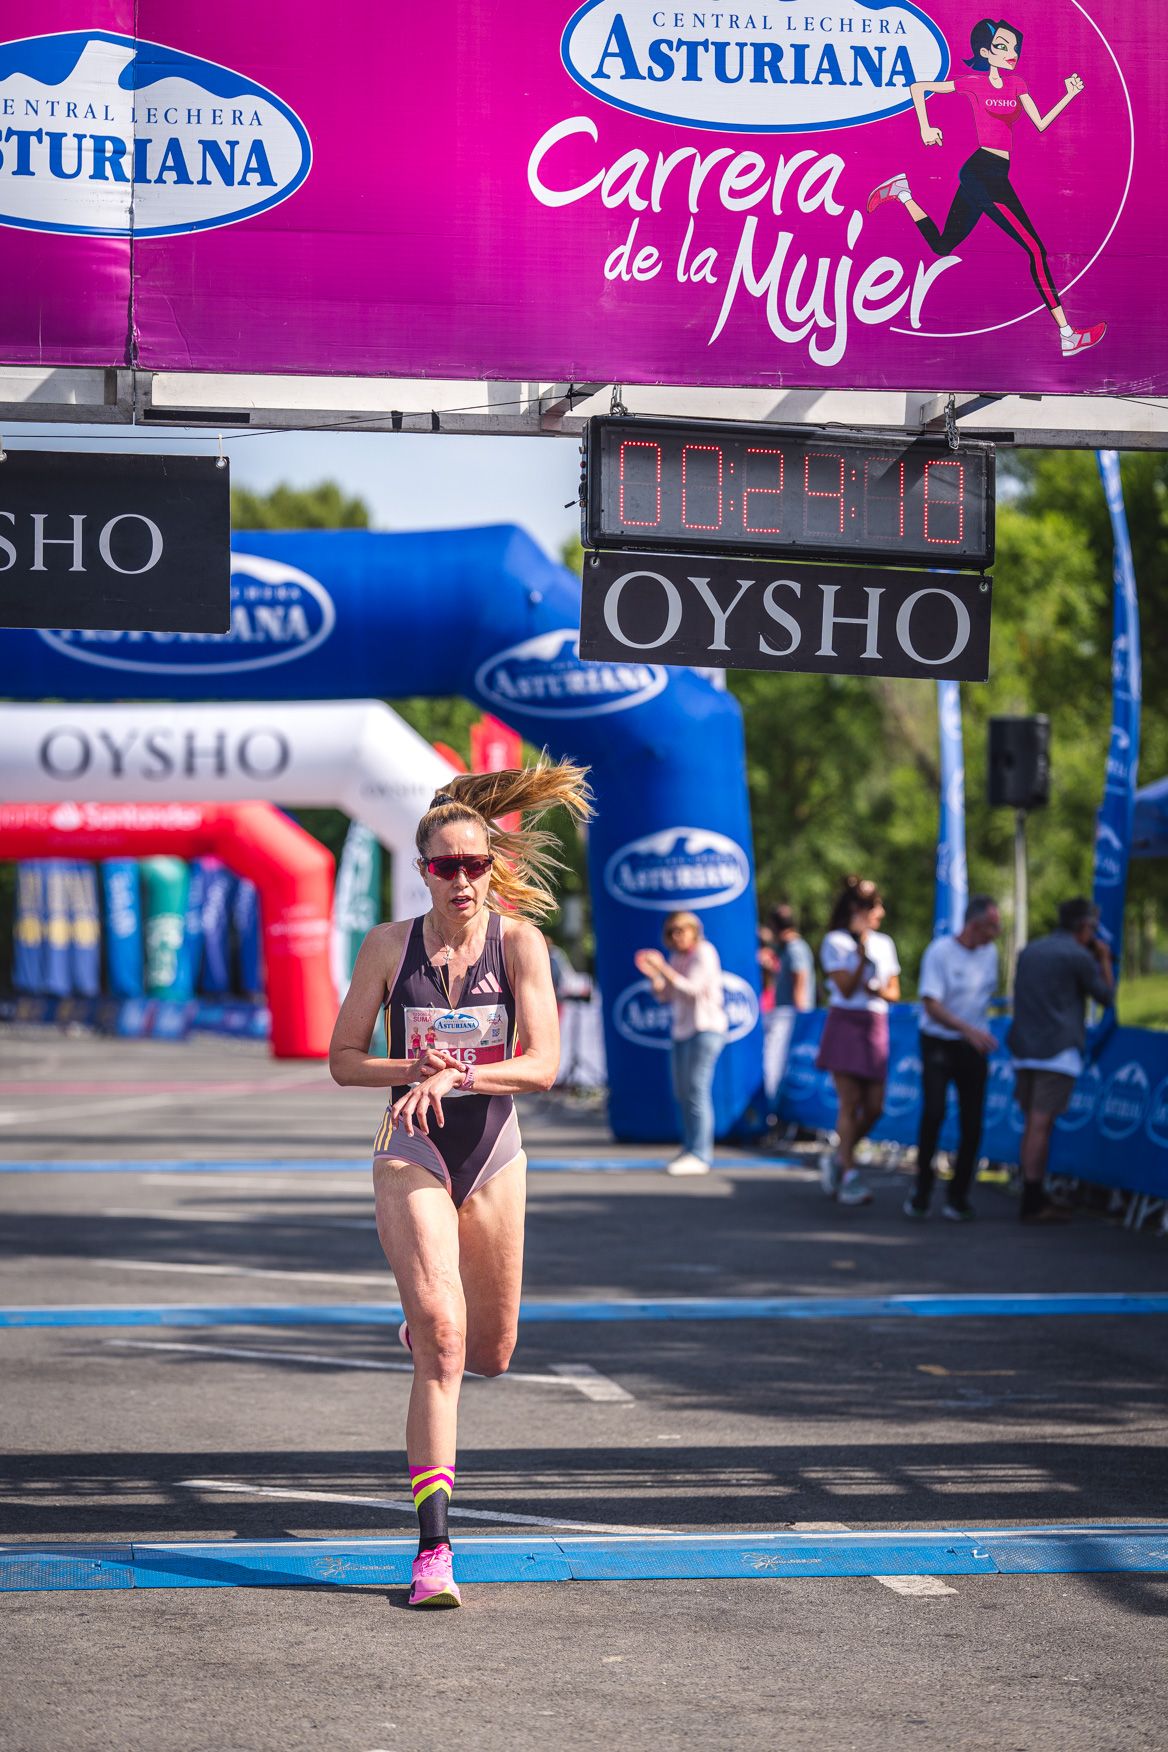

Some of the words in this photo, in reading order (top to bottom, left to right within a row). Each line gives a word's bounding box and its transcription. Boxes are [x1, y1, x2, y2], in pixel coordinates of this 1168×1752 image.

[591, 13, 917, 88] ASTURIANA
[652, 11, 773, 31] CENTRAL
[786, 15, 908, 35] LECHERA
[131, 106, 264, 127] LECHERA
[985, 98, 1017, 108] OYSHO
[0, 126, 278, 187] TURIANA
[526, 115, 846, 216] Carrera
[603, 219, 662, 283] de
[676, 216, 718, 284] la
[708, 210, 963, 367] Mujer
[603, 570, 971, 665] OYSHO
[39, 725, 292, 781] OYSHO
[437, 1021, 477, 1029] ASTURIANA
